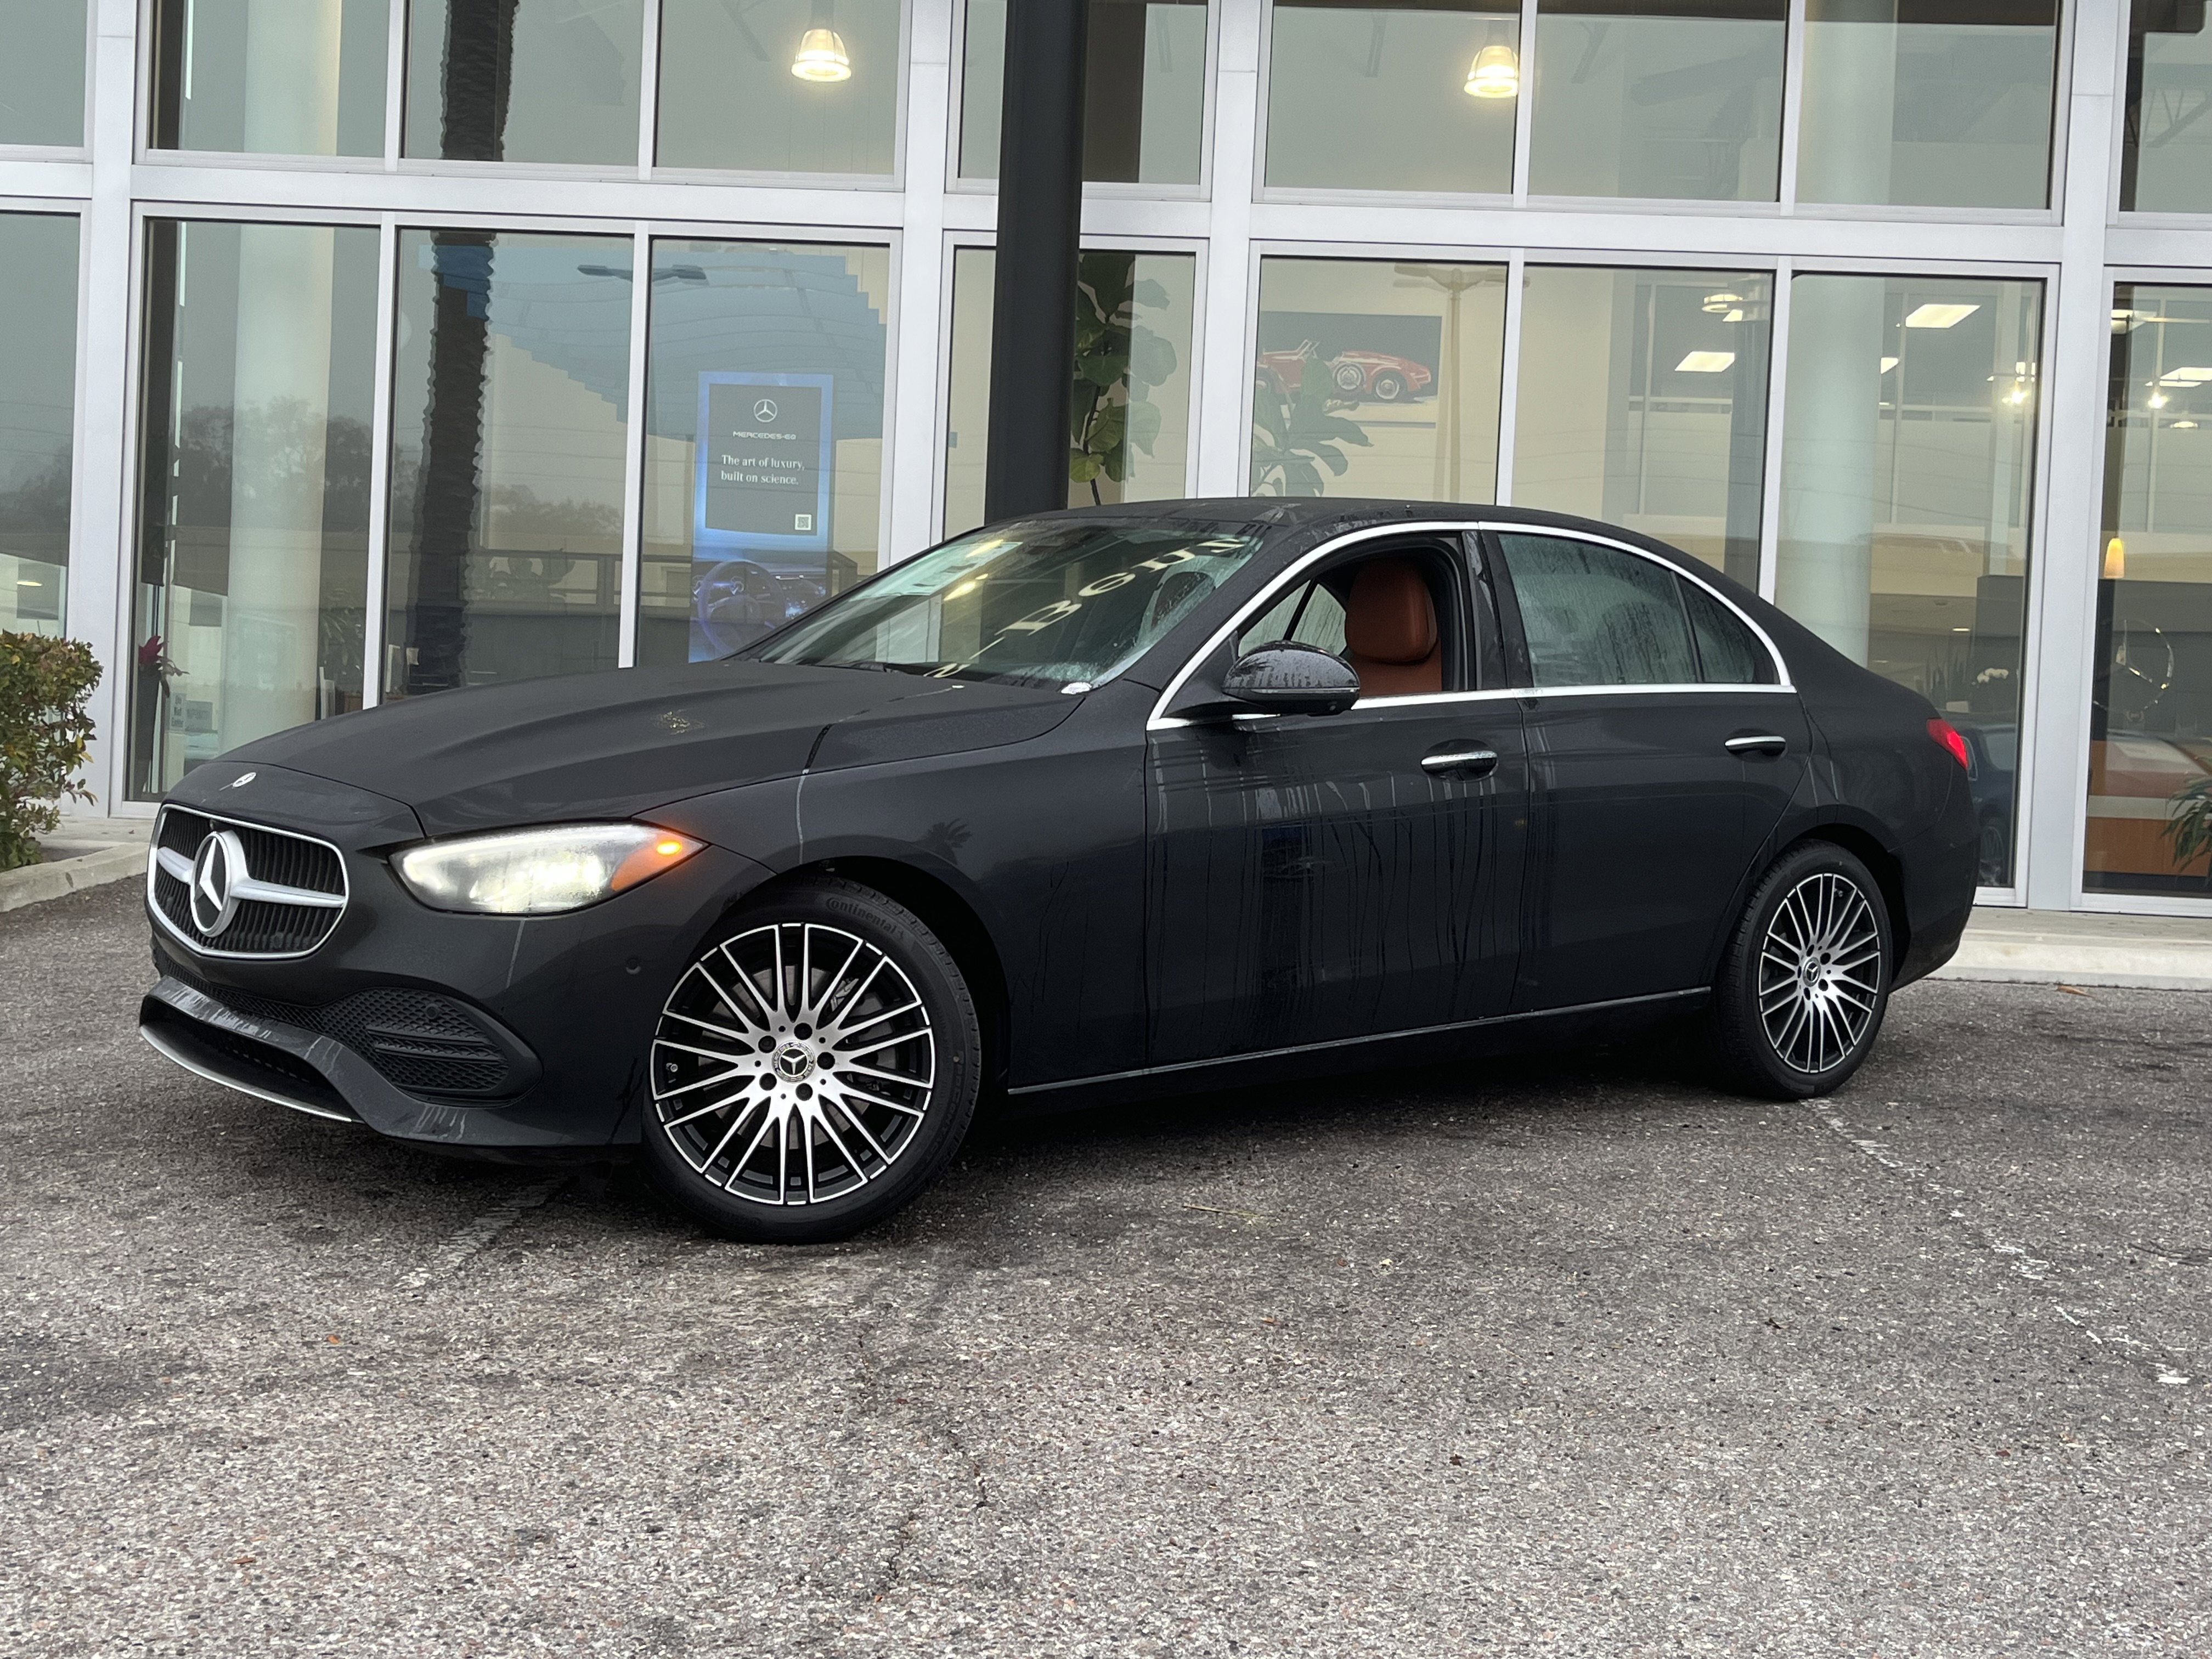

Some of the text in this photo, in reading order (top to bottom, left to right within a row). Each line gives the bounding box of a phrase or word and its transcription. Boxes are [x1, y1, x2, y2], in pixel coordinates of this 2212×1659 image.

[733, 431, 797, 440] MERCEDES-EQ
[721, 454, 805, 471] The art of luxury,
[721, 470, 799, 486] built on science.
[825, 897, 897, 934] Continental
